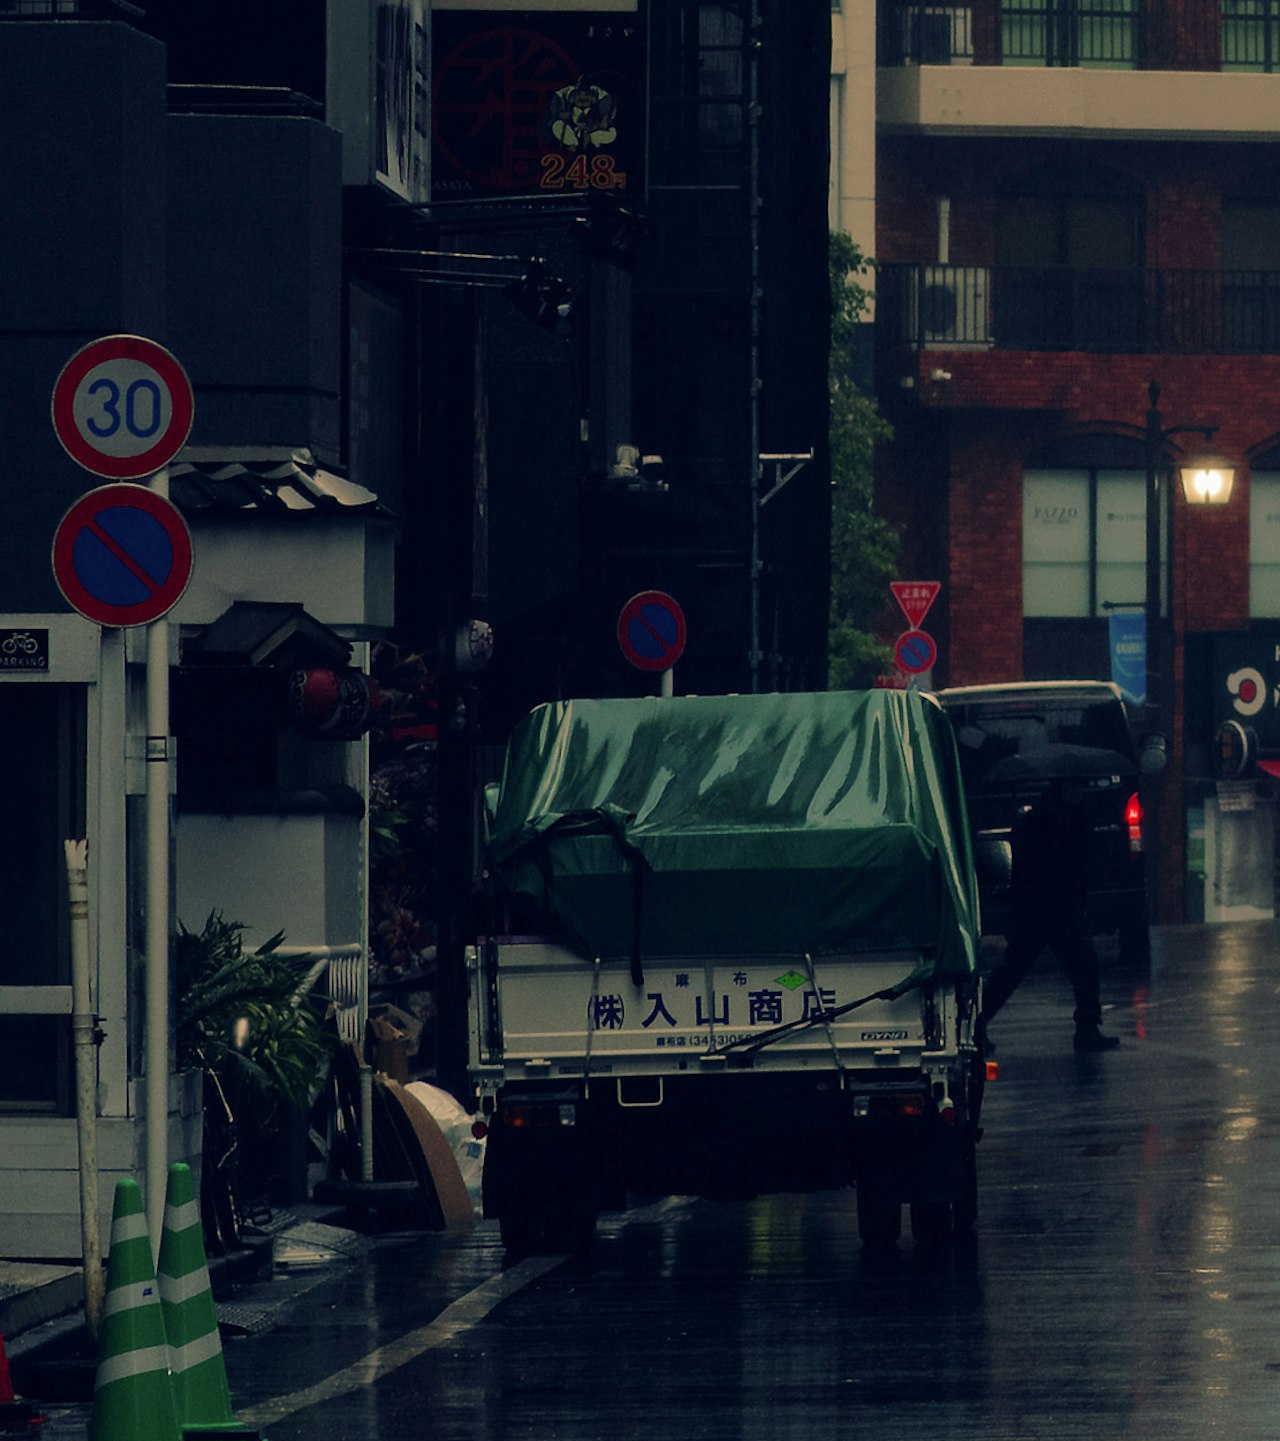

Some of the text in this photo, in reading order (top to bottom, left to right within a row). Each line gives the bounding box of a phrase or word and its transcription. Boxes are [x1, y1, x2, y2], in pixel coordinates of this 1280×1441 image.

[431, 178, 472, 191] ASAYA
[86, 377, 164, 438] 30
[862, 1031, 907, 1041] DYNA
